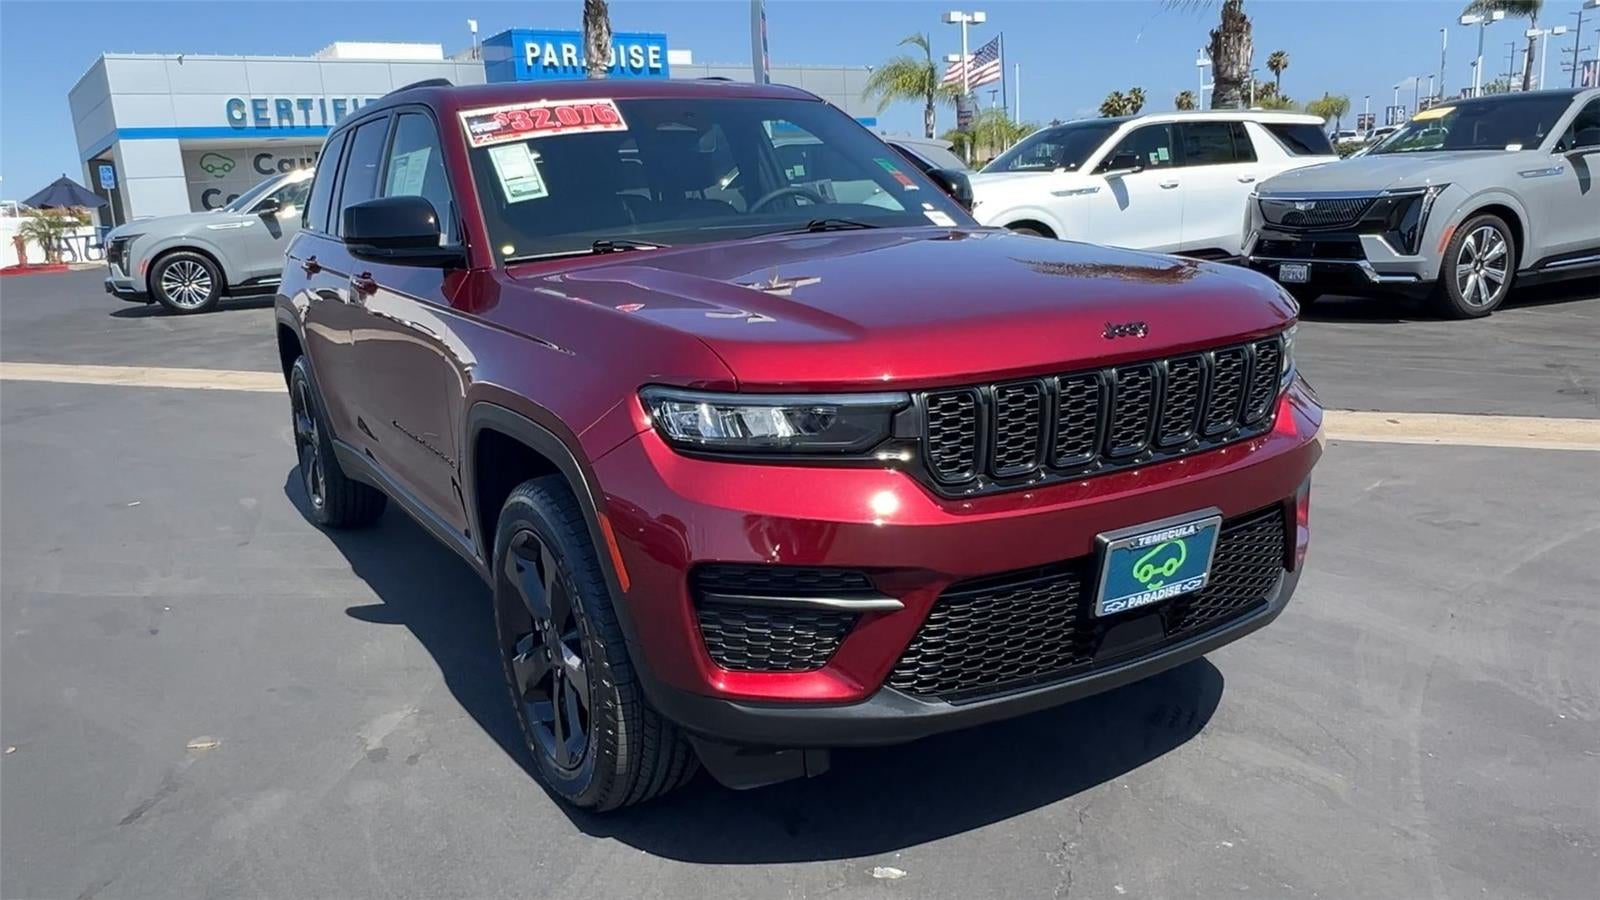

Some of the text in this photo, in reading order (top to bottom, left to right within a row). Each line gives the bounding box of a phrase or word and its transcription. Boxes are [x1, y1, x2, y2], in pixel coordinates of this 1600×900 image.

[525, 43, 662, 68] PARDISE
[253, 151, 320, 175] Car
[1101, 321, 1149, 339] Jeep
[1138, 525, 1196, 546] TEMECULA
[1128, 584, 1182, 608] PARADISE
